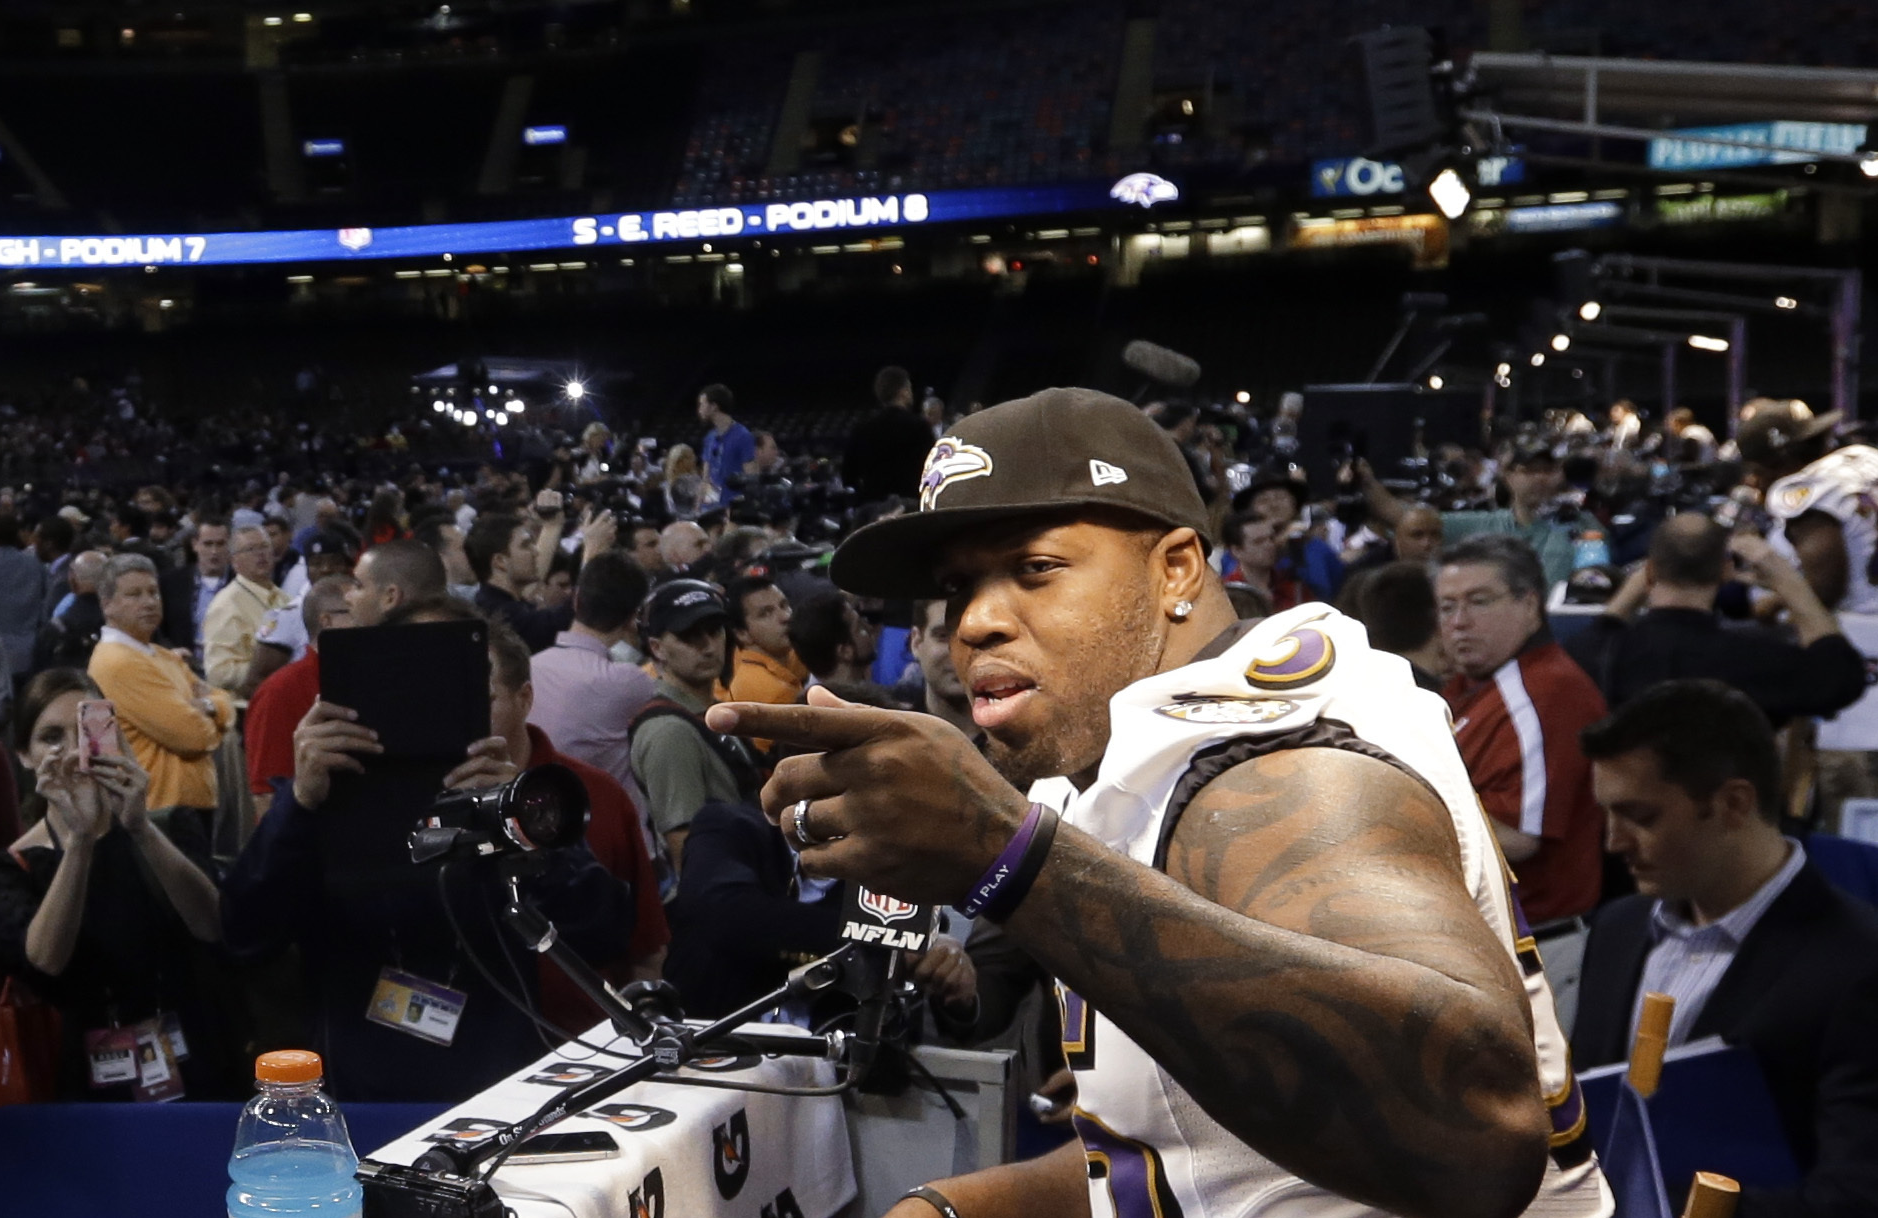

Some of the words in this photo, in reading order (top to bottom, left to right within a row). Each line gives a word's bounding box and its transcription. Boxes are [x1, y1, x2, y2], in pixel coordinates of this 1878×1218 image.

[573, 218, 598, 245] S
[652, 207, 745, 240] REED
[765, 195, 900, 232] PODIUM
[902, 193, 929, 223] 8
[60, 236, 182, 263] PODIUM
[183, 236, 207, 262] 7
[979, 864, 1009, 898] PLAY
[841, 920, 926, 951] NFLN
